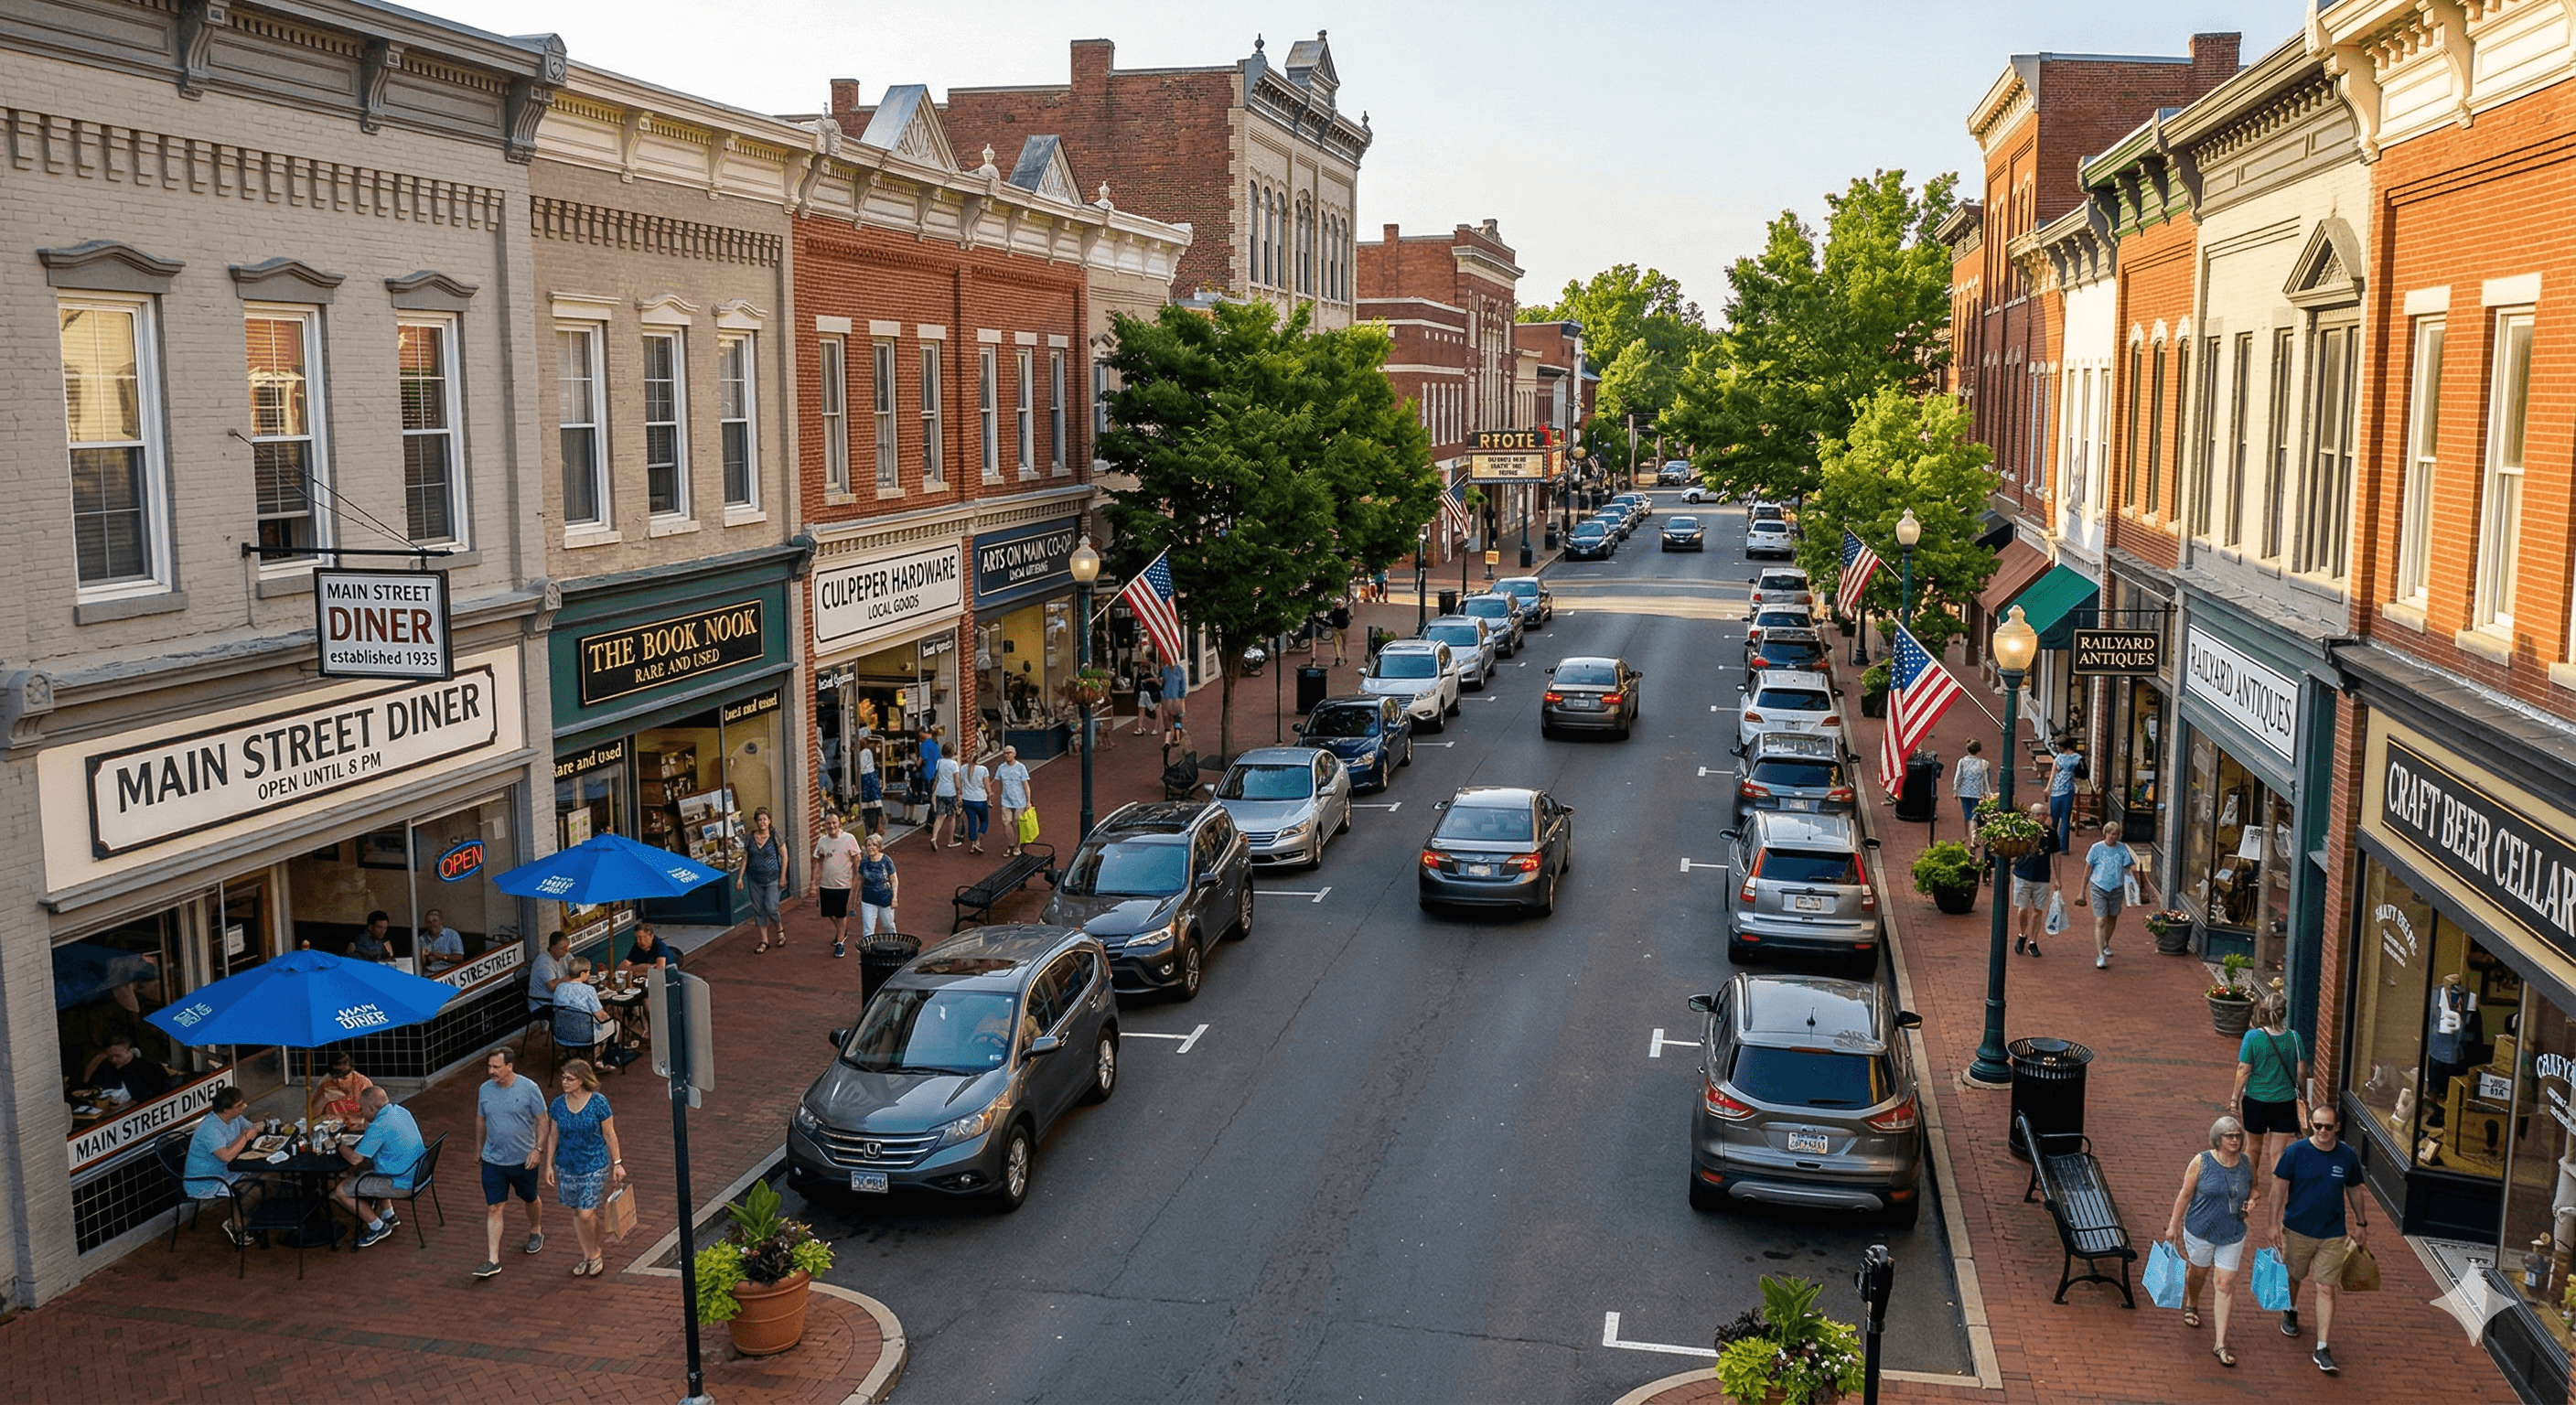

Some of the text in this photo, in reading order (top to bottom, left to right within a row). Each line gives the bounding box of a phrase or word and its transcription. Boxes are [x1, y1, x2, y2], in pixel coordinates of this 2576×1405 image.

[982, 548, 1005, 574] ARTS
[1006, 544, 1021, 567] ON
[1024, 538, 1046, 563] MAIN
[1046, 533, 1072, 557] CO-OP
[327, 583, 432, 602] MAIN STREET
[821, 554, 956, 610] CULPEPER HARDWARE
[328, 606, 435, 644] DINER
[868, 594, 919, 620] LOCAL GOODS
[330, 649, 437, 666] established 1935
[588, 608, 758, 673] THE BOOK NOOK
[2078, 651, 2155, 668] ANTIQUES
[2080, 637, 2154, 650] RAILYARD
[634, 648, 720, 683] RARE AND USED
[2190, 642, 2292, 737] RAILYARD ANTIQUES
[115, 682, 482, 813] MAIN STREET DINER
[576, 749, 596, 771] and
[257, 751, 381, 801] OPEN UNTIL 8 PM
[441, 844, 483, 877] OPEN
[2388, 761, 2442, 839] CRAFT
[2441, 793, 2491, 875] BEER
[2494, 827, 2576, 938] CELLAR
[76, 1126, 117, 1163] MAIN
[122, 1099, 177, 1141] STREET
